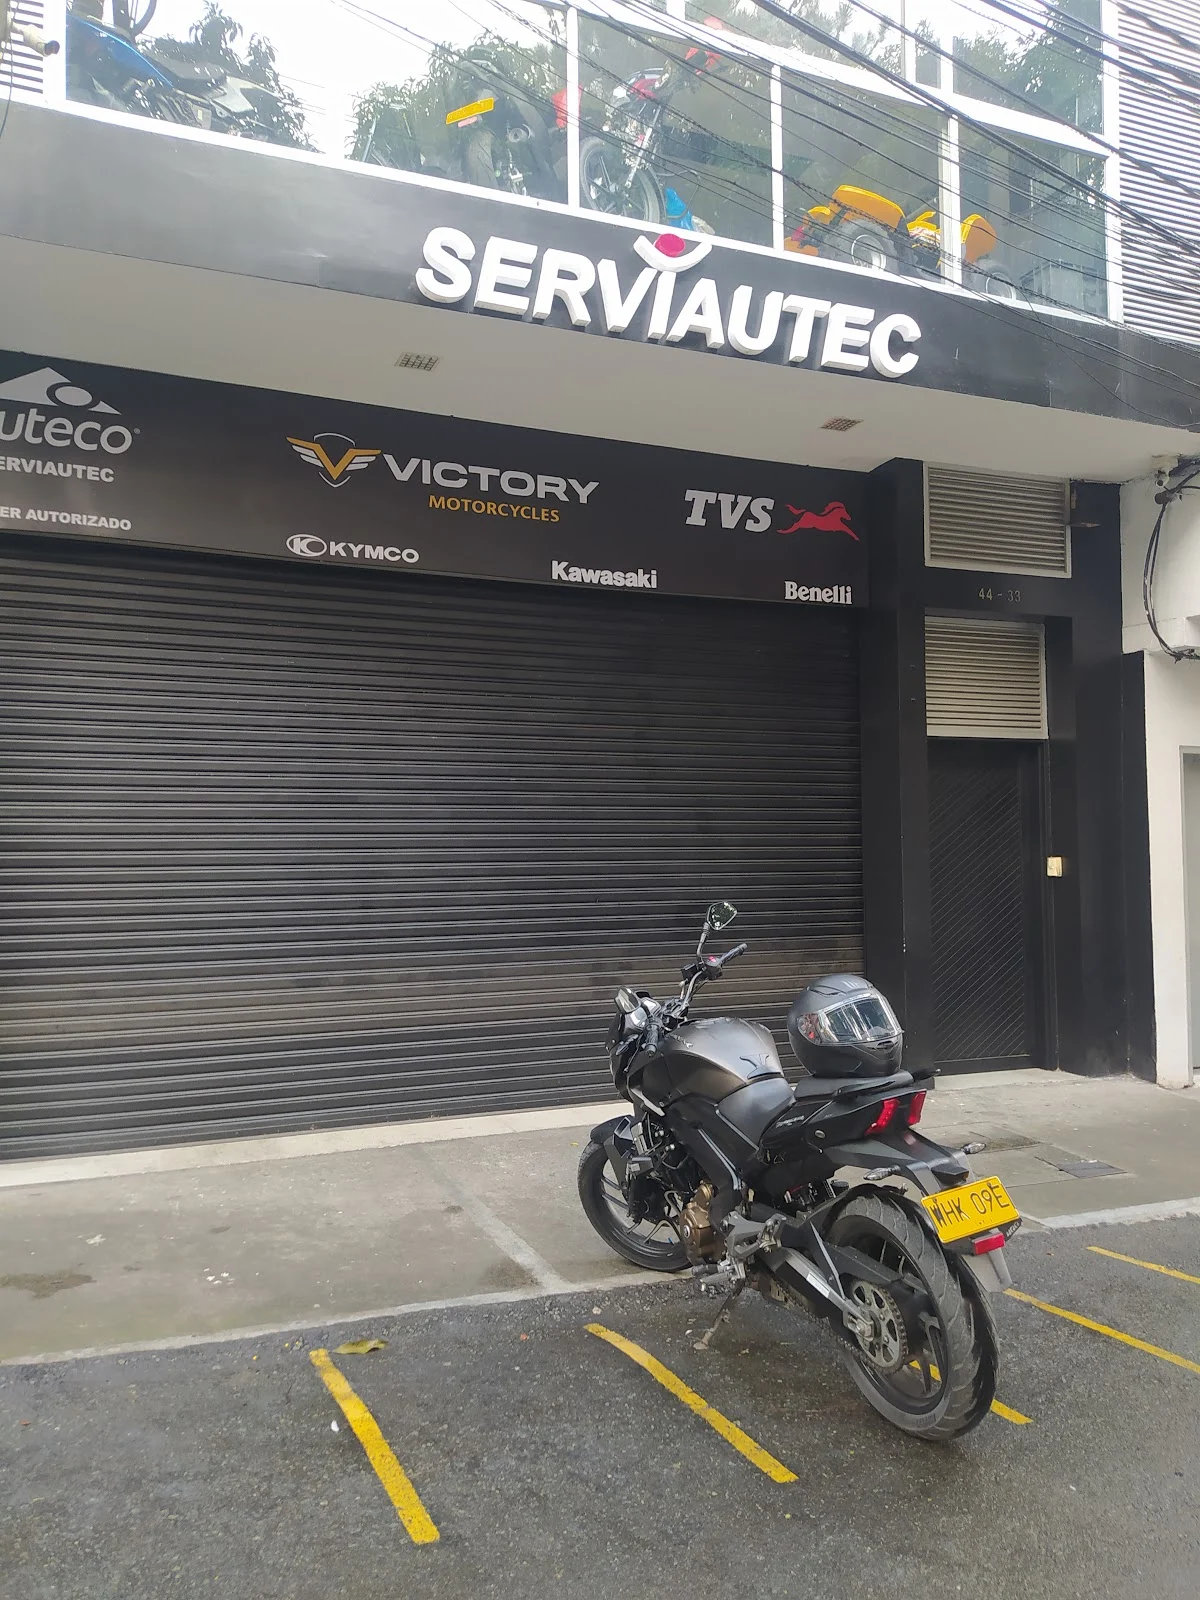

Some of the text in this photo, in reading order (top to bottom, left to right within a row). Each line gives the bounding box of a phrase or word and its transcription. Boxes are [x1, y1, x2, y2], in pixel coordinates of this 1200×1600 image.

[415, 226, 921, 378] SERVIAUTEC
[382, 453, 600, 504] VICTORY
[0, 505, 132, 530] ER AUTORIZADO
[428, 495, 560, 522] MOTORCYCLES
[684, 489, 775, 533] TVS
[329, 541, 419, 563] KYMCO
[551, 560, 657, 589] Kawasaki
[784, 581, 852, 605] Benelli
[979, 588, 993, 600] 44
[1007, 589, 1021, 602] 33
[930, 1184, 1010, 1228] WHK 09E
